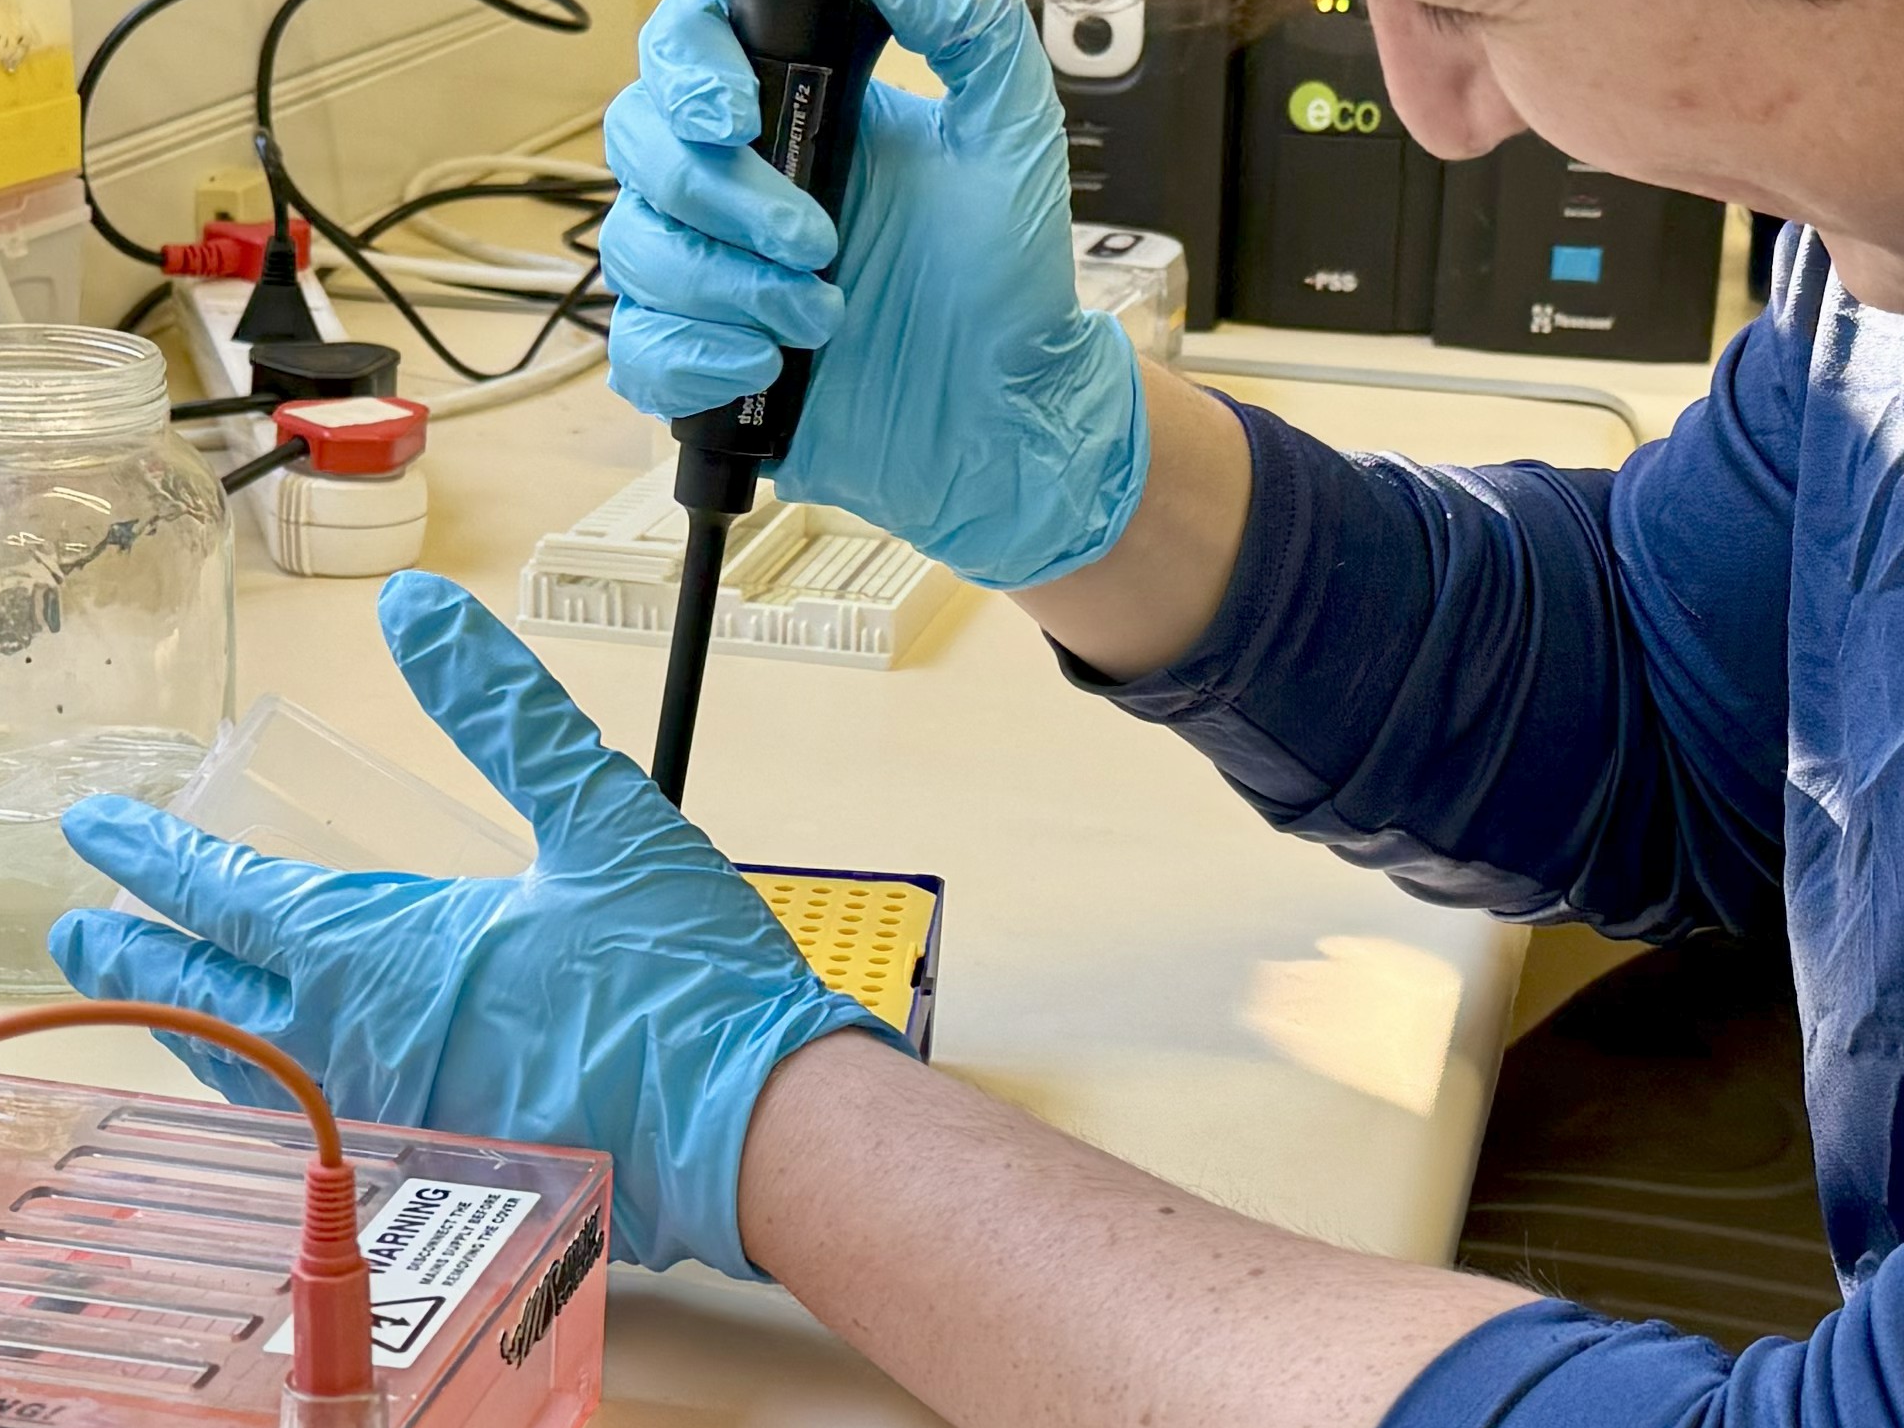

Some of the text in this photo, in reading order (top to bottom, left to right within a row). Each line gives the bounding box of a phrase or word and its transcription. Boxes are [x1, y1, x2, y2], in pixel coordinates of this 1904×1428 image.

[1306, 98, 1382, 134] eco
[367, 1187, 452, 1274] WARNING
[406, 1201, 473, 1272] DISCONNECT THE
